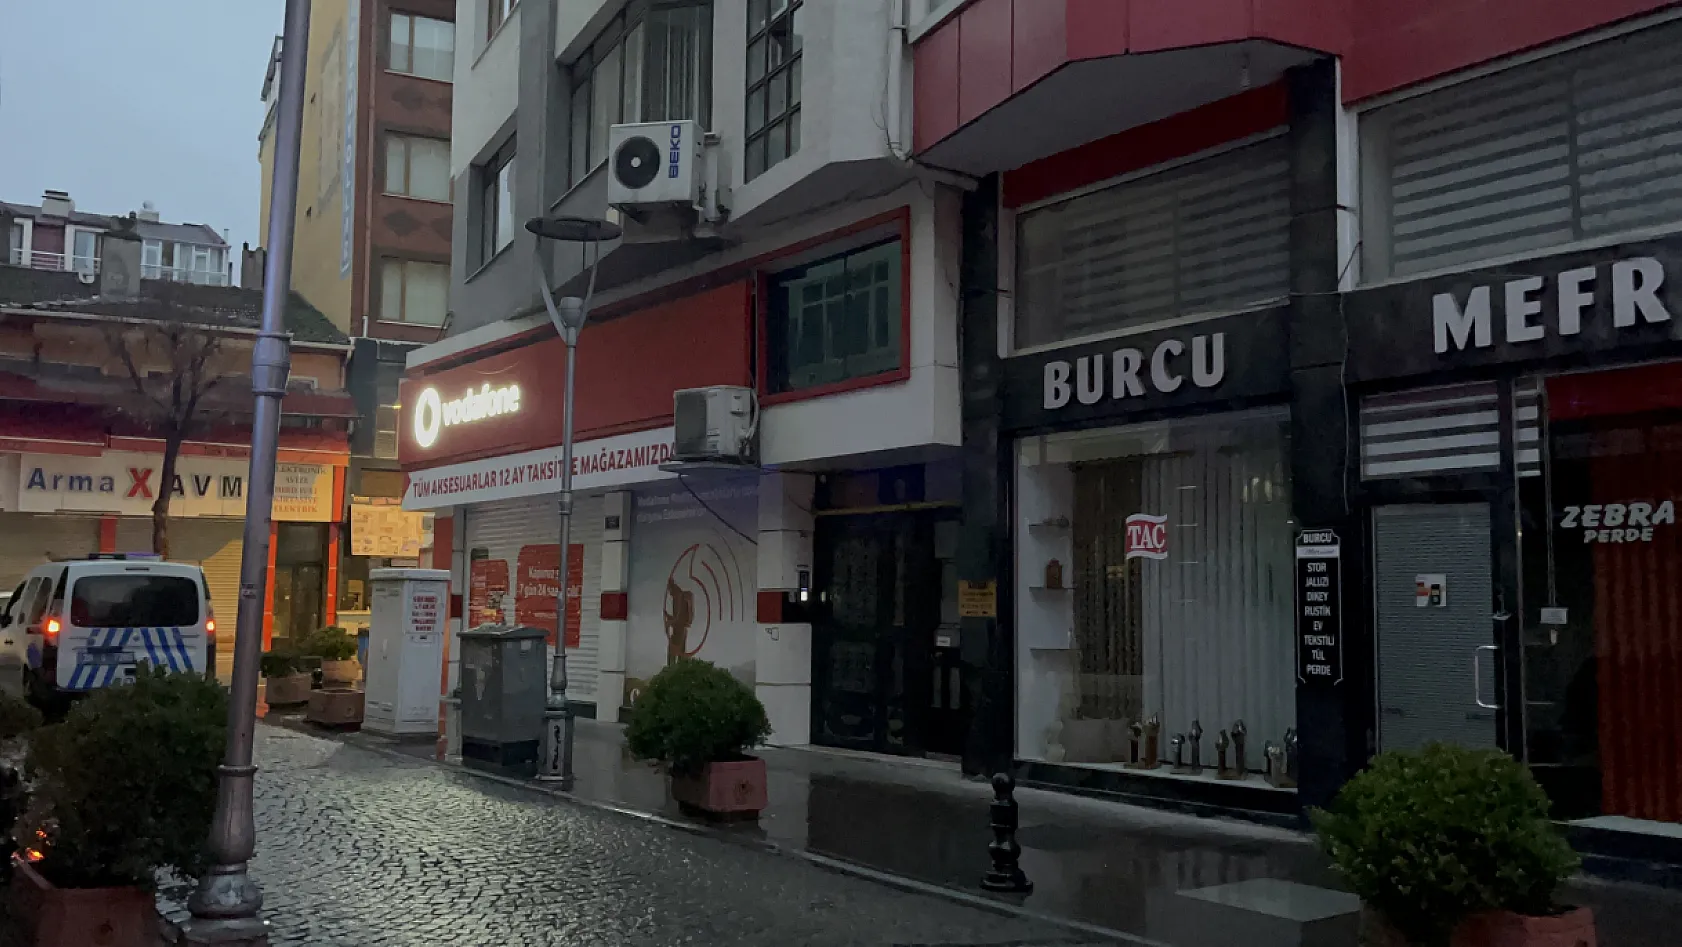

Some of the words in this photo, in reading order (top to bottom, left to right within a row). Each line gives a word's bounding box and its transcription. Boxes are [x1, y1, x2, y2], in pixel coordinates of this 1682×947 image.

[668, 125, 682, 179] BEKO
[1043, 332, 1226, 410] BURCU
[442, 383, 520, 427] vodafone
[27, 467, 115, 492] Arma
[127, 467, 154, 498] X
[171, 474, 243, 498] AVM
[413, 481, 431, 498] TÜM
[431, 470, 497, 496] AKSESUARLAR
[499, 468, 511, 486] 12
[511, 467, 525, 484] AY
[527, 455, 578, 482] TAKSİTE
[1560, 500, 1675, 528] ZEBRA
[1303, 532, 1332, 543] BURCU
[1583, 527, 1654, 544] PERDE
[1307, 562, 1327, 573] STOR
[1313, 620, 1324, 632] EV
[1306, 664, 1332, 676] PERDE
